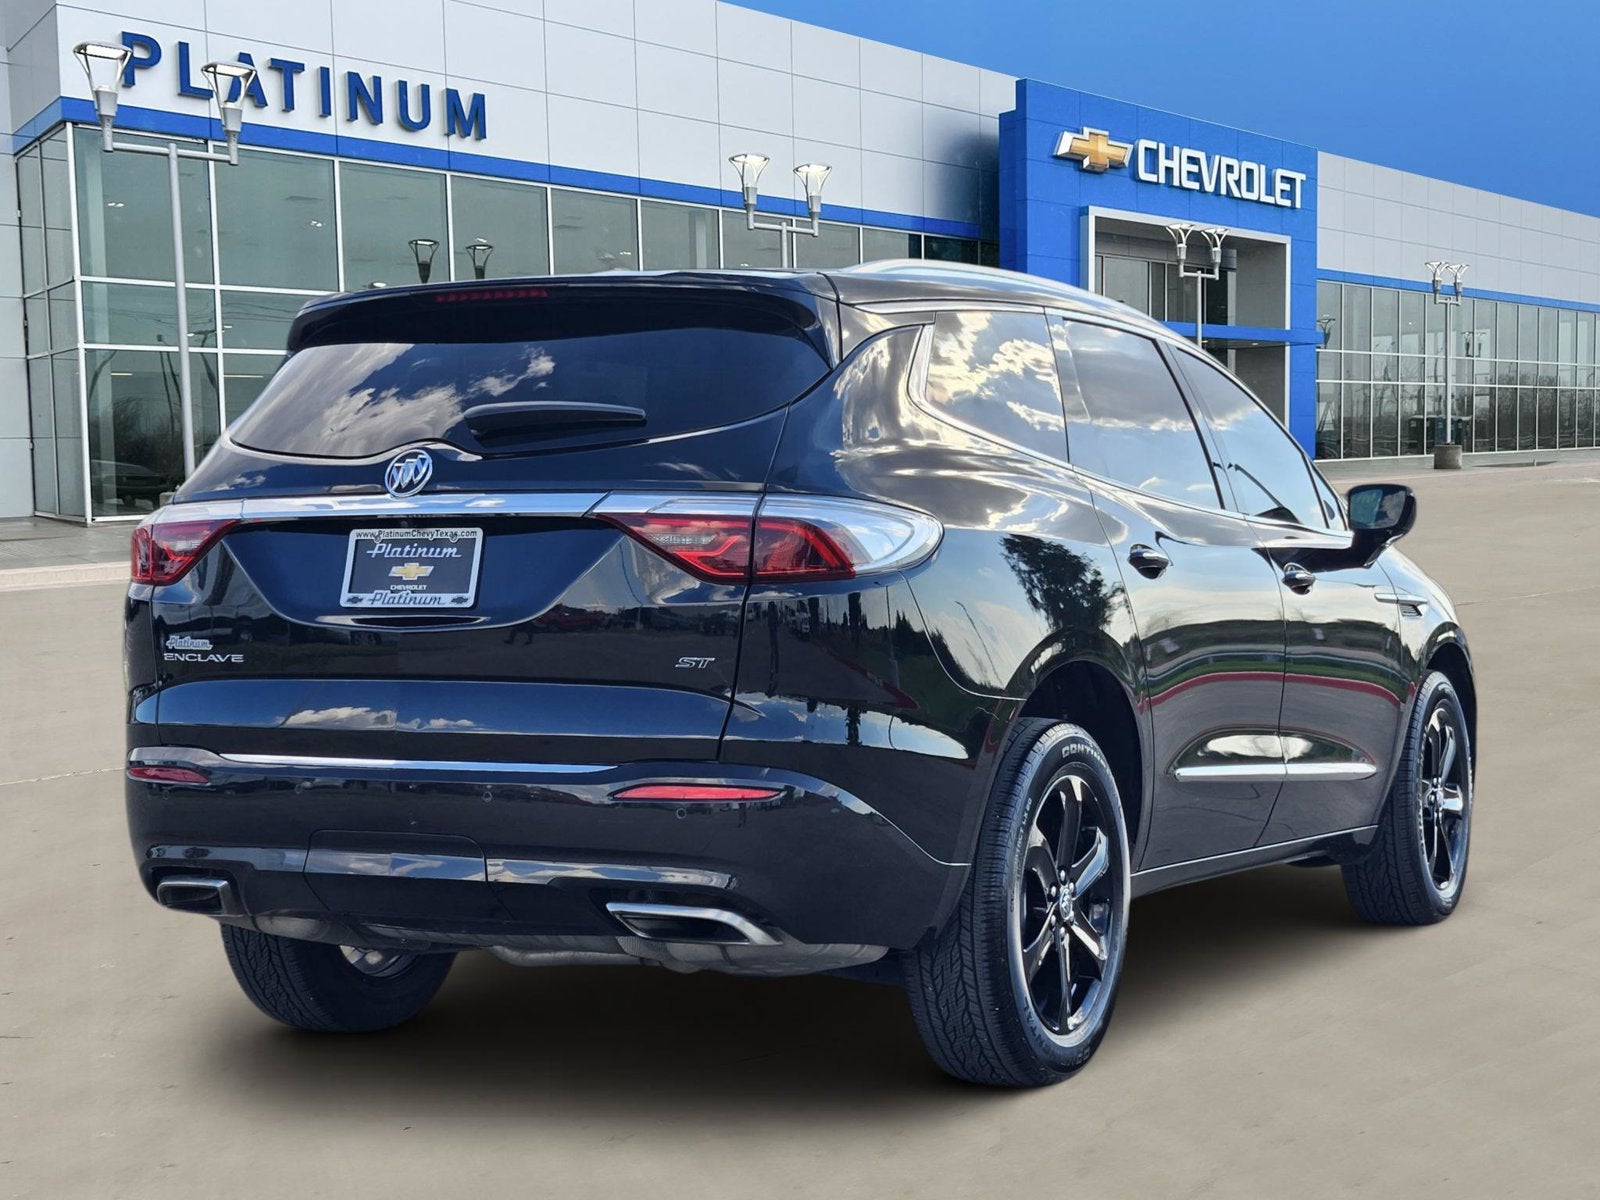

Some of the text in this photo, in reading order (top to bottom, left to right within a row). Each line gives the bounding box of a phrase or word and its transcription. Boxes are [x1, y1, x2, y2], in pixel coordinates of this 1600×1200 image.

[121, 31, 487, 141] PLATINUM
[1136, 138, 1306, 209] CHEVROLET
[366, 543, 462, 558] Platinum
[368, 591, 446, 605] Platinum
[166, 635, 213, 650] Platinum
[163, 653, 244, 662] ENCLAVE
[675, 656, 716, 669] ST
